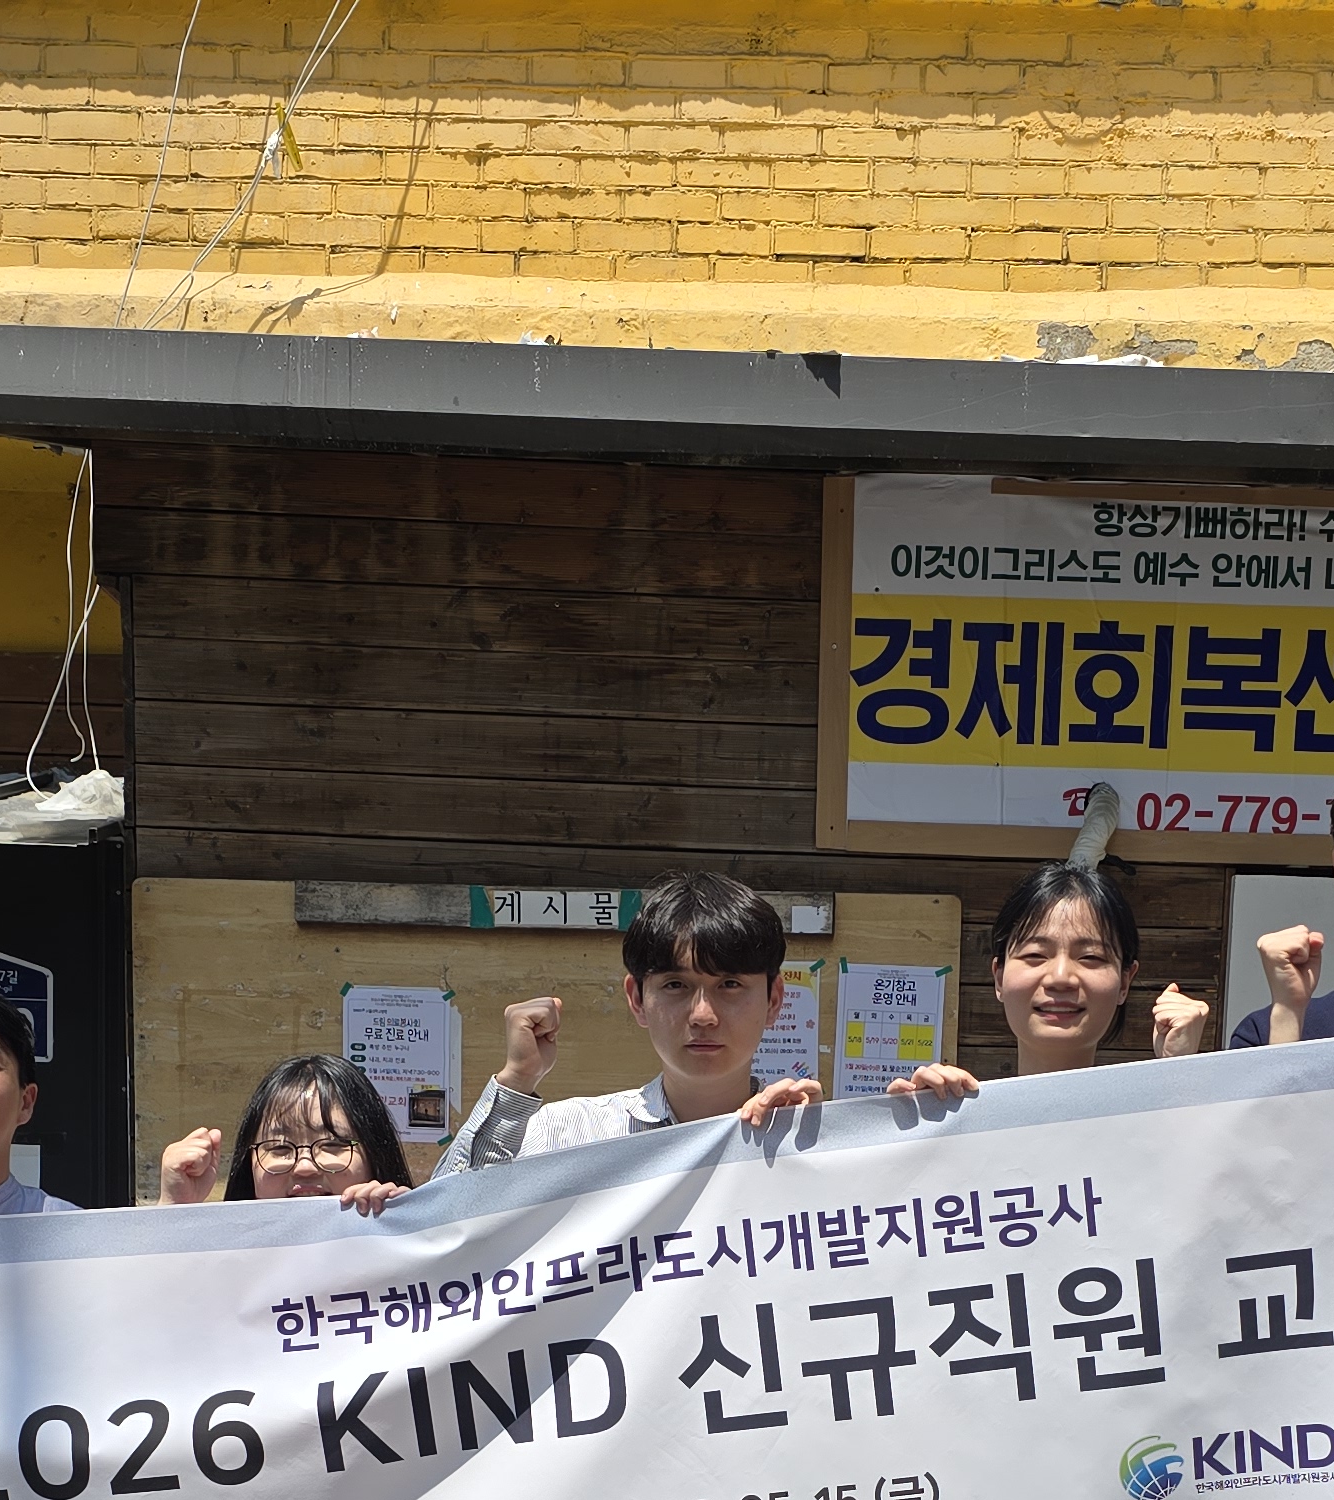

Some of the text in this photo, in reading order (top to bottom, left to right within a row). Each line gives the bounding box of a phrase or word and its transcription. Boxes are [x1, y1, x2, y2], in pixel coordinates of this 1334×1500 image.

[1093, 502, 1306, 542] 항상기뻐하라!
[890, 544, 1122, 585] 이것이그리스도
[1133, 551, 1200, 588] 예수
[1210, 552, 1313, 590] 안에서
[1136, 791, 1333, 836] 02-779-
[783, 970, 802, 981] 잔치
[873, 978, 917, 993] 온기창고
[871, 992, 917, 1007] 운영 안내
[853, 1011, 930, 1023] 월 화 수 목 금
[364, 1027, 430, 1043] 무료 진료 안내
[848, 1035, 933, 1047] 5/18 5/19 5/20 5/21 5/22
[271, 1176, 1103, 1354] 한국해외인프라도시개발지원공사
[315, 1338, 628, 1475] KIND
[677, 1256, 1168, 1435] 신규직원
